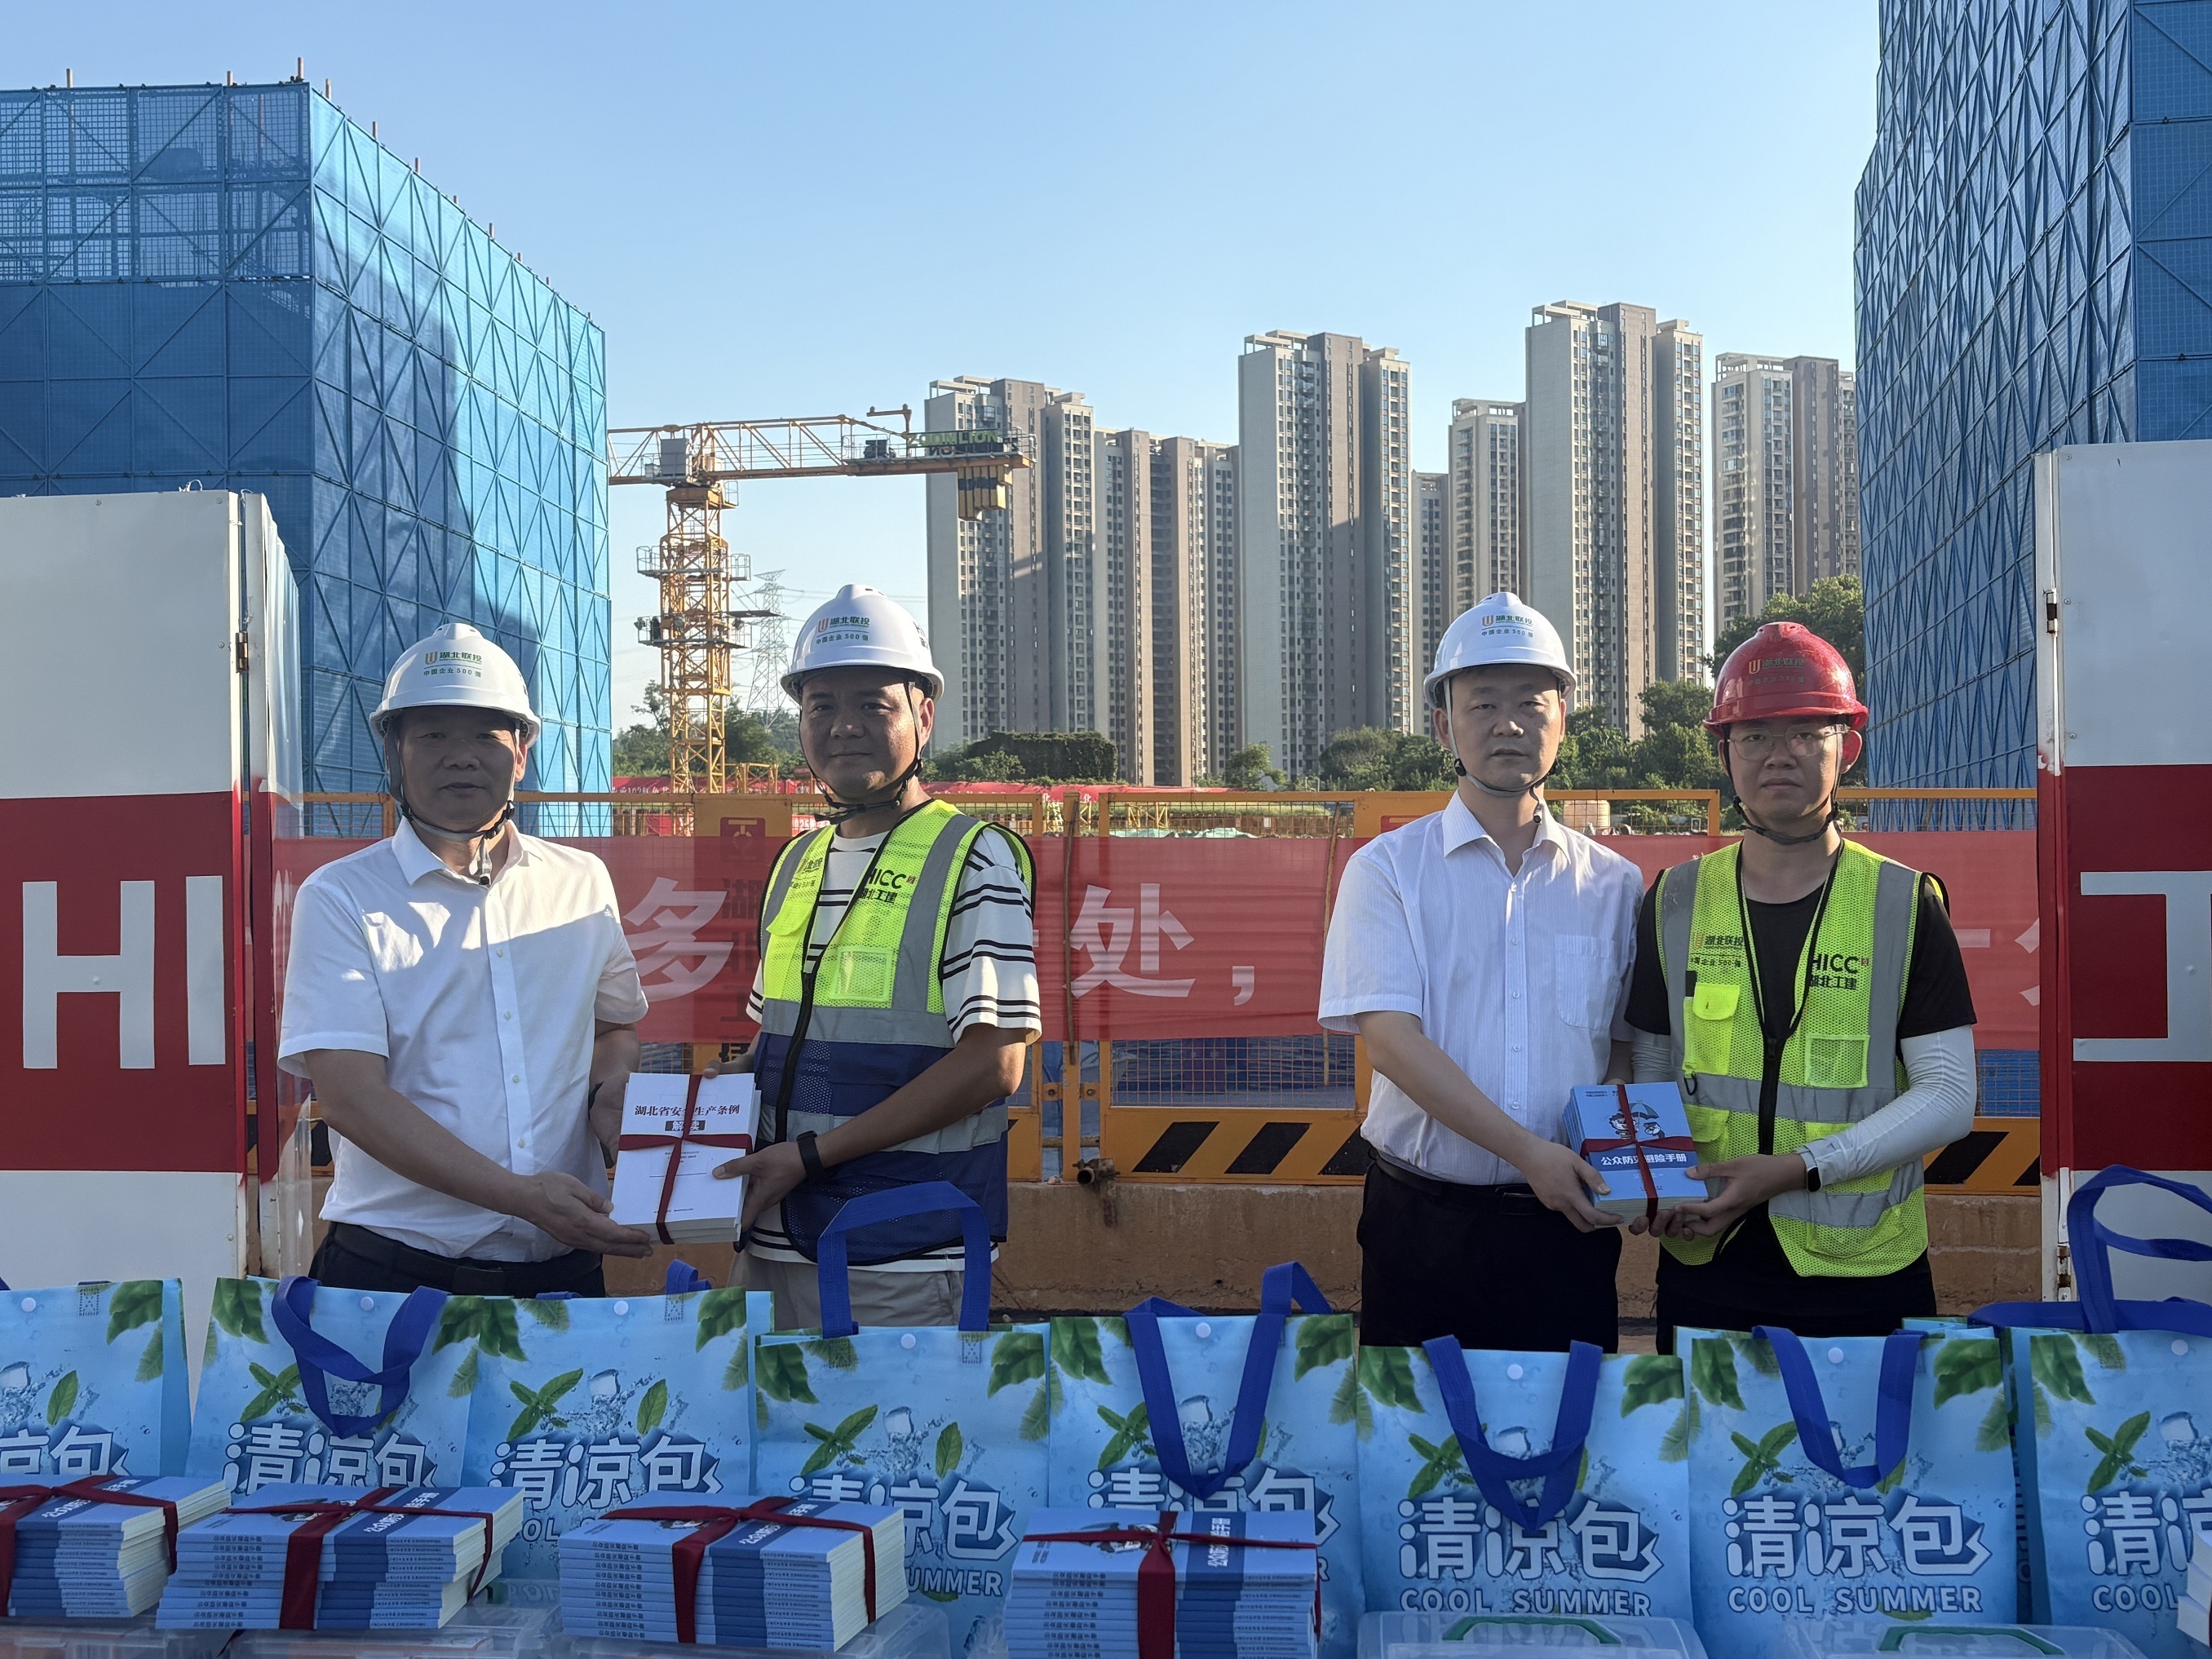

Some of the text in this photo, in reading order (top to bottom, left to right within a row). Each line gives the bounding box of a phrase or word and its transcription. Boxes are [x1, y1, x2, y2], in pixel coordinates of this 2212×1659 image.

[622, 876, 734, 1002] 多
[23, 875, 225, 1069] HI
[635, 1104, 741, 1117] 湖北省安生产条例
[1398, 1496, 1664, 1583] 清凉包
[1722, 1494, 1993, 1579] 清凉包
[905, 1567, 1003, 1597] UMMER
[2092, 1582, 2180, 1613] COOL
[1400, 1587, 1652, 1617] COOL SUMMER
[1727, 1586, 1984, 1614] COOL SUMMER
